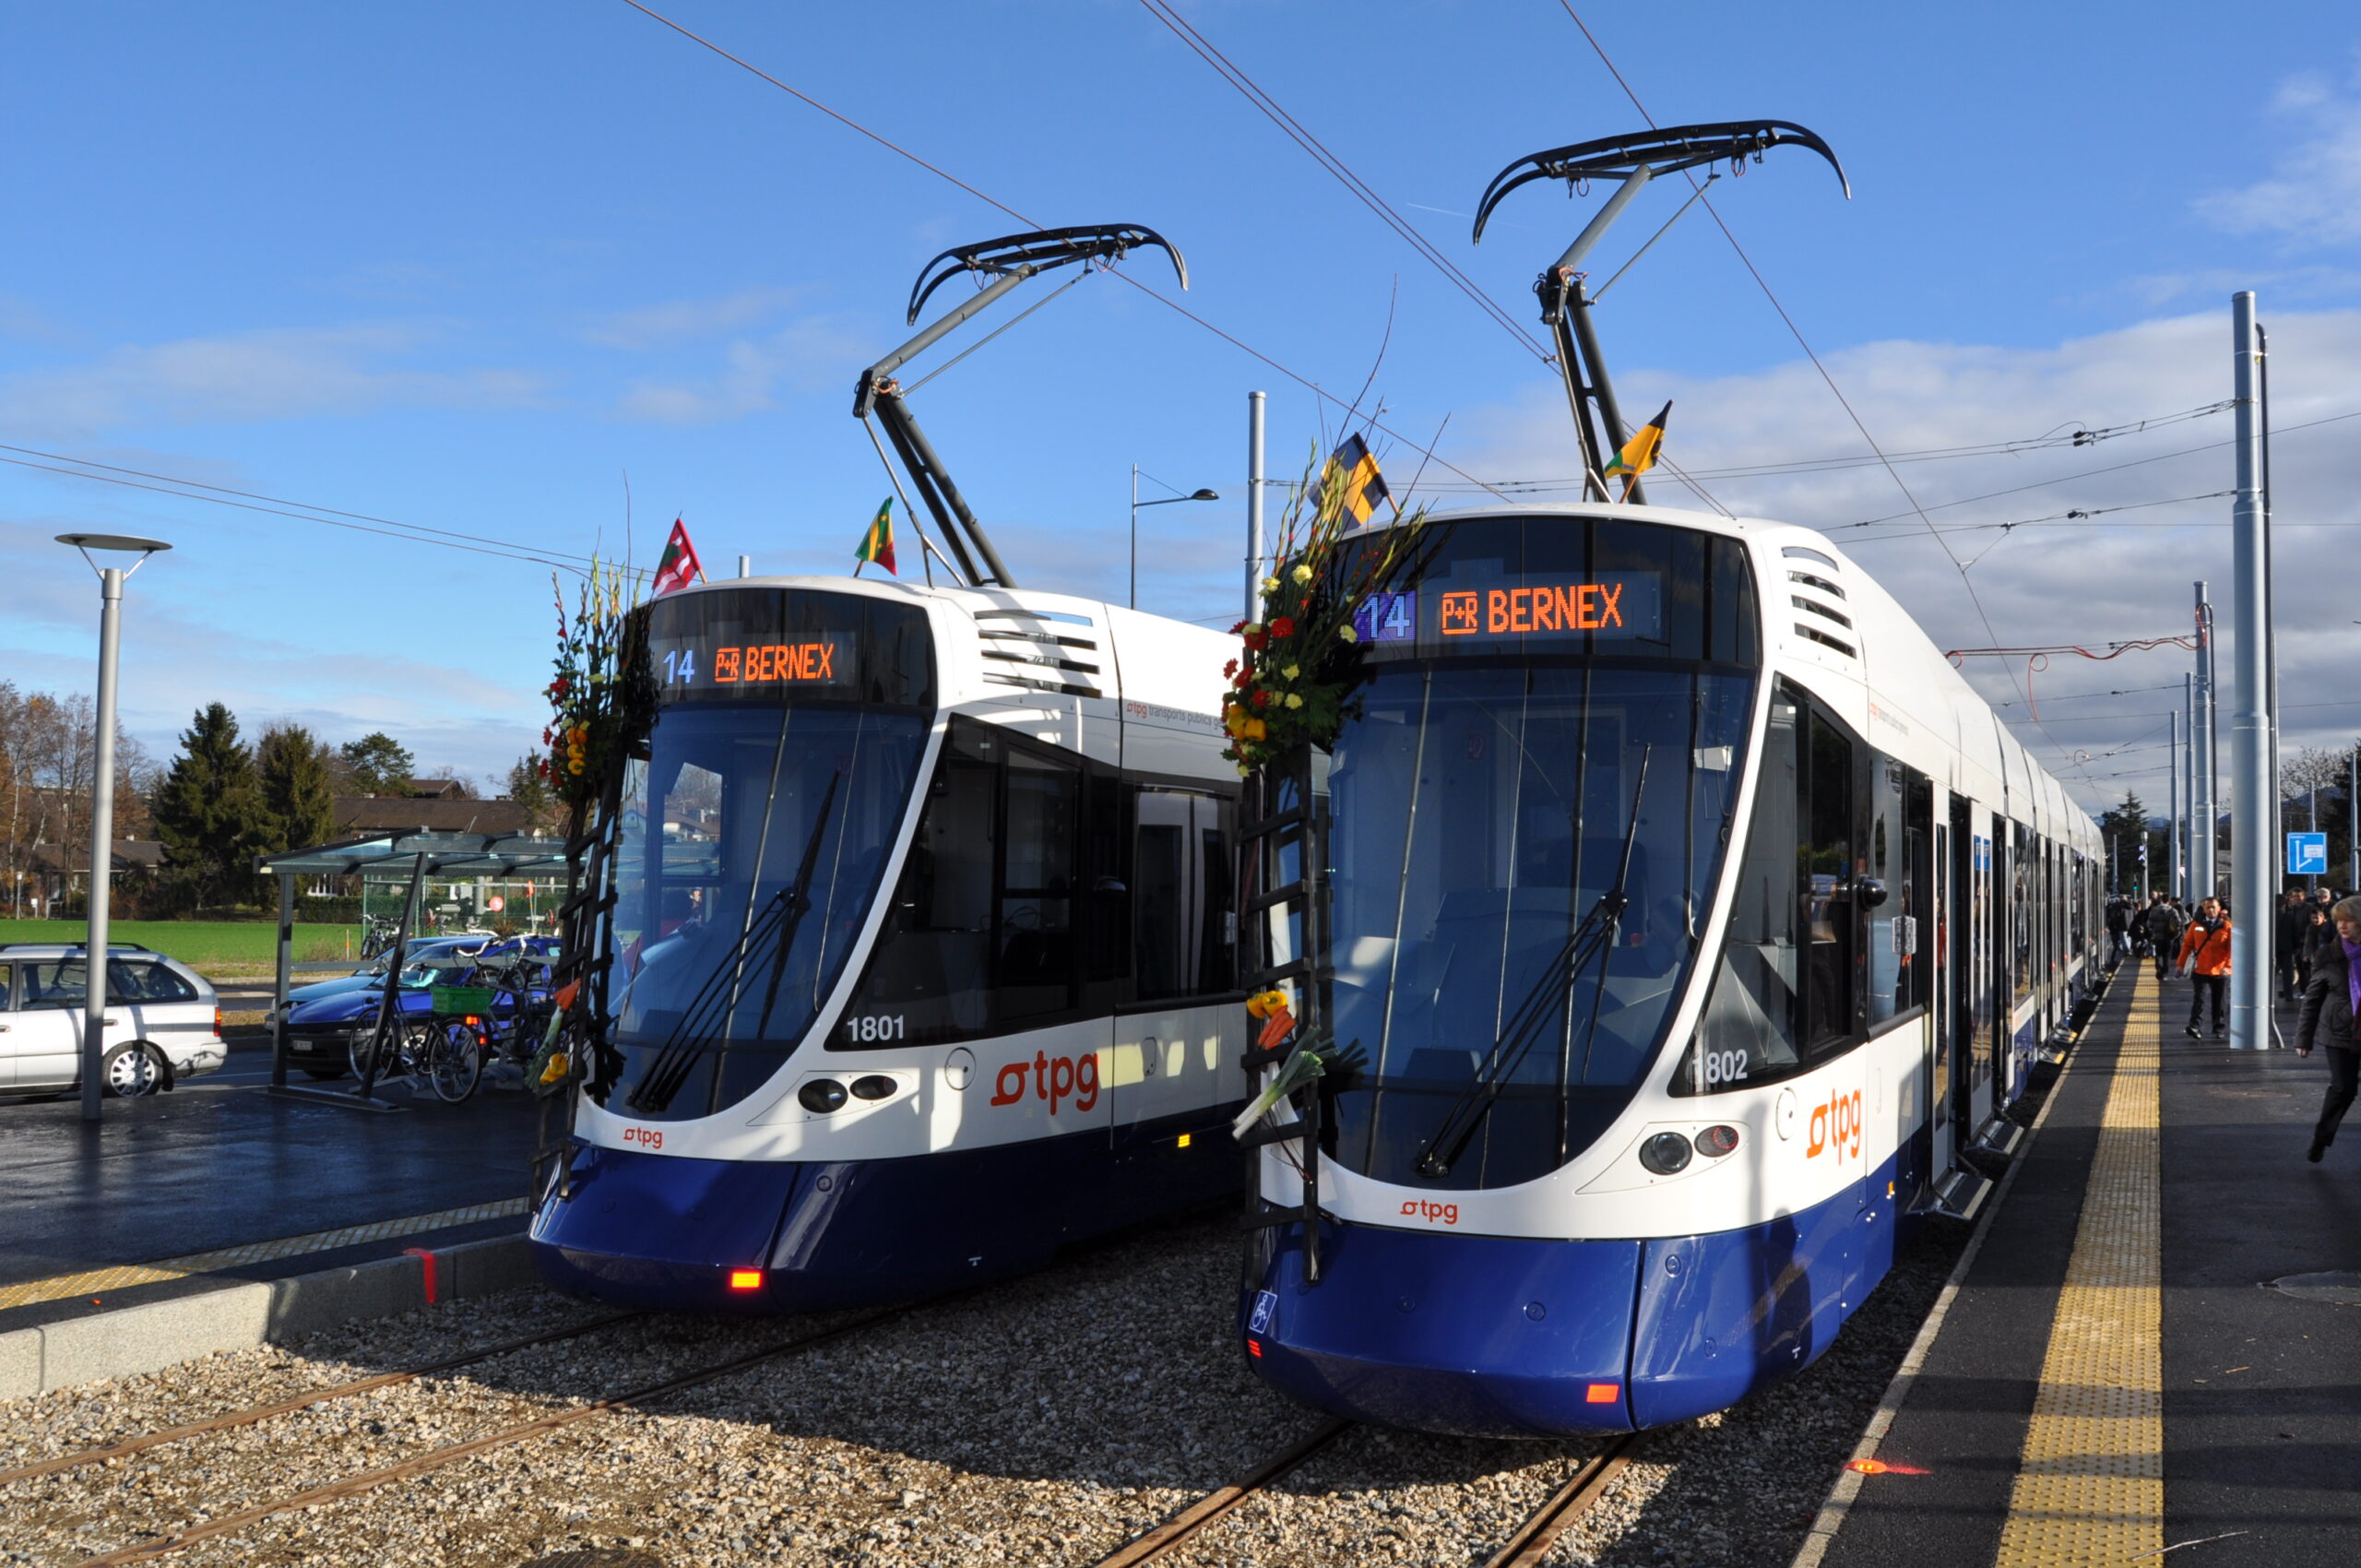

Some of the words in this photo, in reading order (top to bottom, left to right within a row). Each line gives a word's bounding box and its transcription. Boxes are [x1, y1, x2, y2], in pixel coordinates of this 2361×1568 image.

[1358, 594, 1410, 638] 14
[1488, 583, 1622, 634] BERNEX
[662, 649, 695, 684] 14
[743, 643, 834, 682] BERNEX
[1149, 705, 1186, 722] transports
[1187, 712, 1213, 726] publics
[847, 1015, 905, 1042] 1801
[1691, 1049, 1749, 1084] 1802
